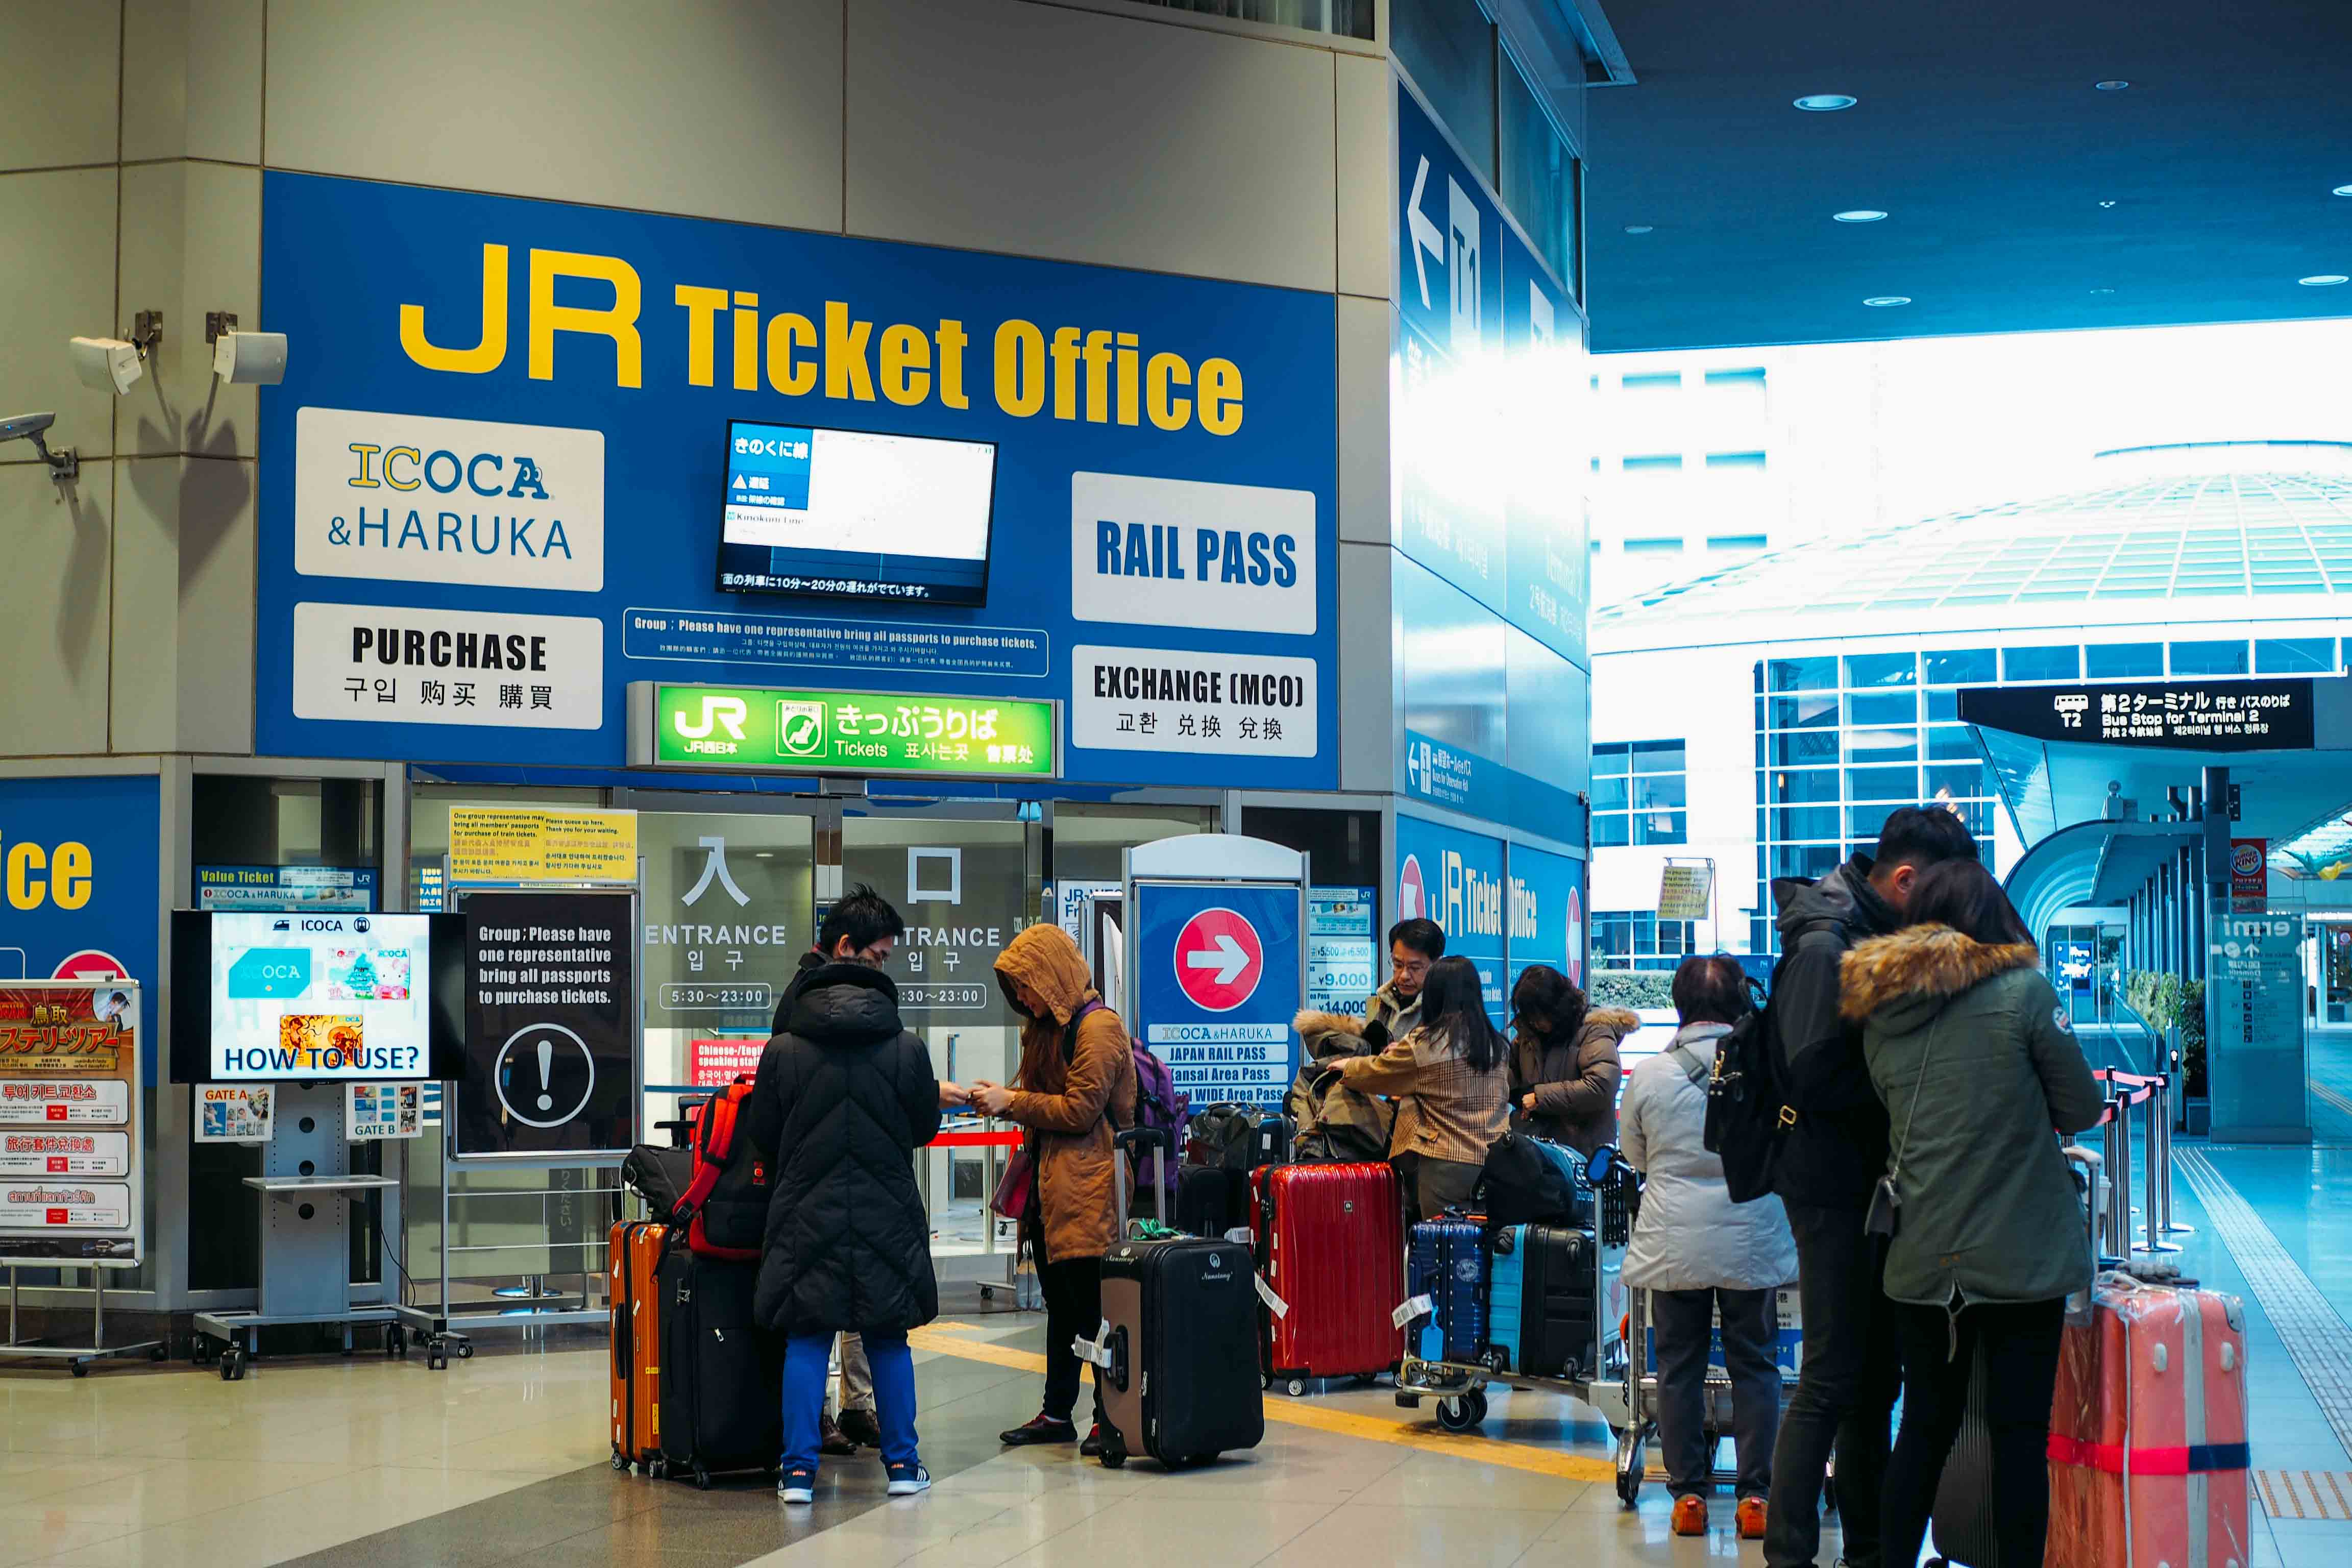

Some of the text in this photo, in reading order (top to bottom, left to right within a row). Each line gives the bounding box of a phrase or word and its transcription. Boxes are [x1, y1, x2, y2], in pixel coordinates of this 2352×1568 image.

[400, 242, 1243, 436] JR Ticket Office
[348, 443, 550, 500] ICOCA
[1097, 520, 1296, 588] RAIL PASS
[635, 617, 1038, 650] Group Please have one representative bring all passports to purchase tickets.
[353, 626, 546, 672] PURCHASE
[420, 679, 476, 707] 购买
[499, 683, 552, 710] 購買
[1094, 665, 1221, 704] EXCHANGE
[2100, 691, 2210, 713] 第2ターミナル
[2240, 694, 2290, 708] バスのりば
[674, 695, 747, 740] JR
[835, 703, 999, 740] きっぷうりば
[2061, 709, 2260, 727] T2 Bus Stop for Terminal 2
[834, 740, 888, 758] Tickets
[487, 813, 530, 821] representative
[0, 829, 92, 910] ce
[2236, 856, 2259, 867] KING
[201, 870, 235, 883] Value
[238, 871, 275, 883] Ticket
[681, 837, 751, 907] 入
[907, 847, 961, 905] 口
[1432, 849, 1537, 940] JR Ticket Office
[302, 919, 343, 932] ICOCA
[529, 927, 575, 942] Please
[579, 926, 611, 942] have
[645, 925, 786, 945] ENTRANCE
[894, 927, 1000, 947] TRANCE
[479, 948, 611, 964] one representative
[479, 968, 611, 985] bring all passports
[479, 989, 611, 1006] to purchase tickets.
[1163, 1027, 1211, 1040] ICOCA
[225, 1046, 419, 1071] HOW TO USE?
[1170, 1046, 1266, 1061] JAPAN RAIL PASS
[1212, 1068, 1239, 1081] Area
[1242, 1067, 1270, 1081] Pass
[205, 1090, 248, 1101] GATE A
[1195, 1088, 1224, 1102] WIDE
[1227, 1088, 1253, 1101] Area
[1256, 1088, 1283, 1101] Pass
[355, 1124, 396, 1136] GATE B
